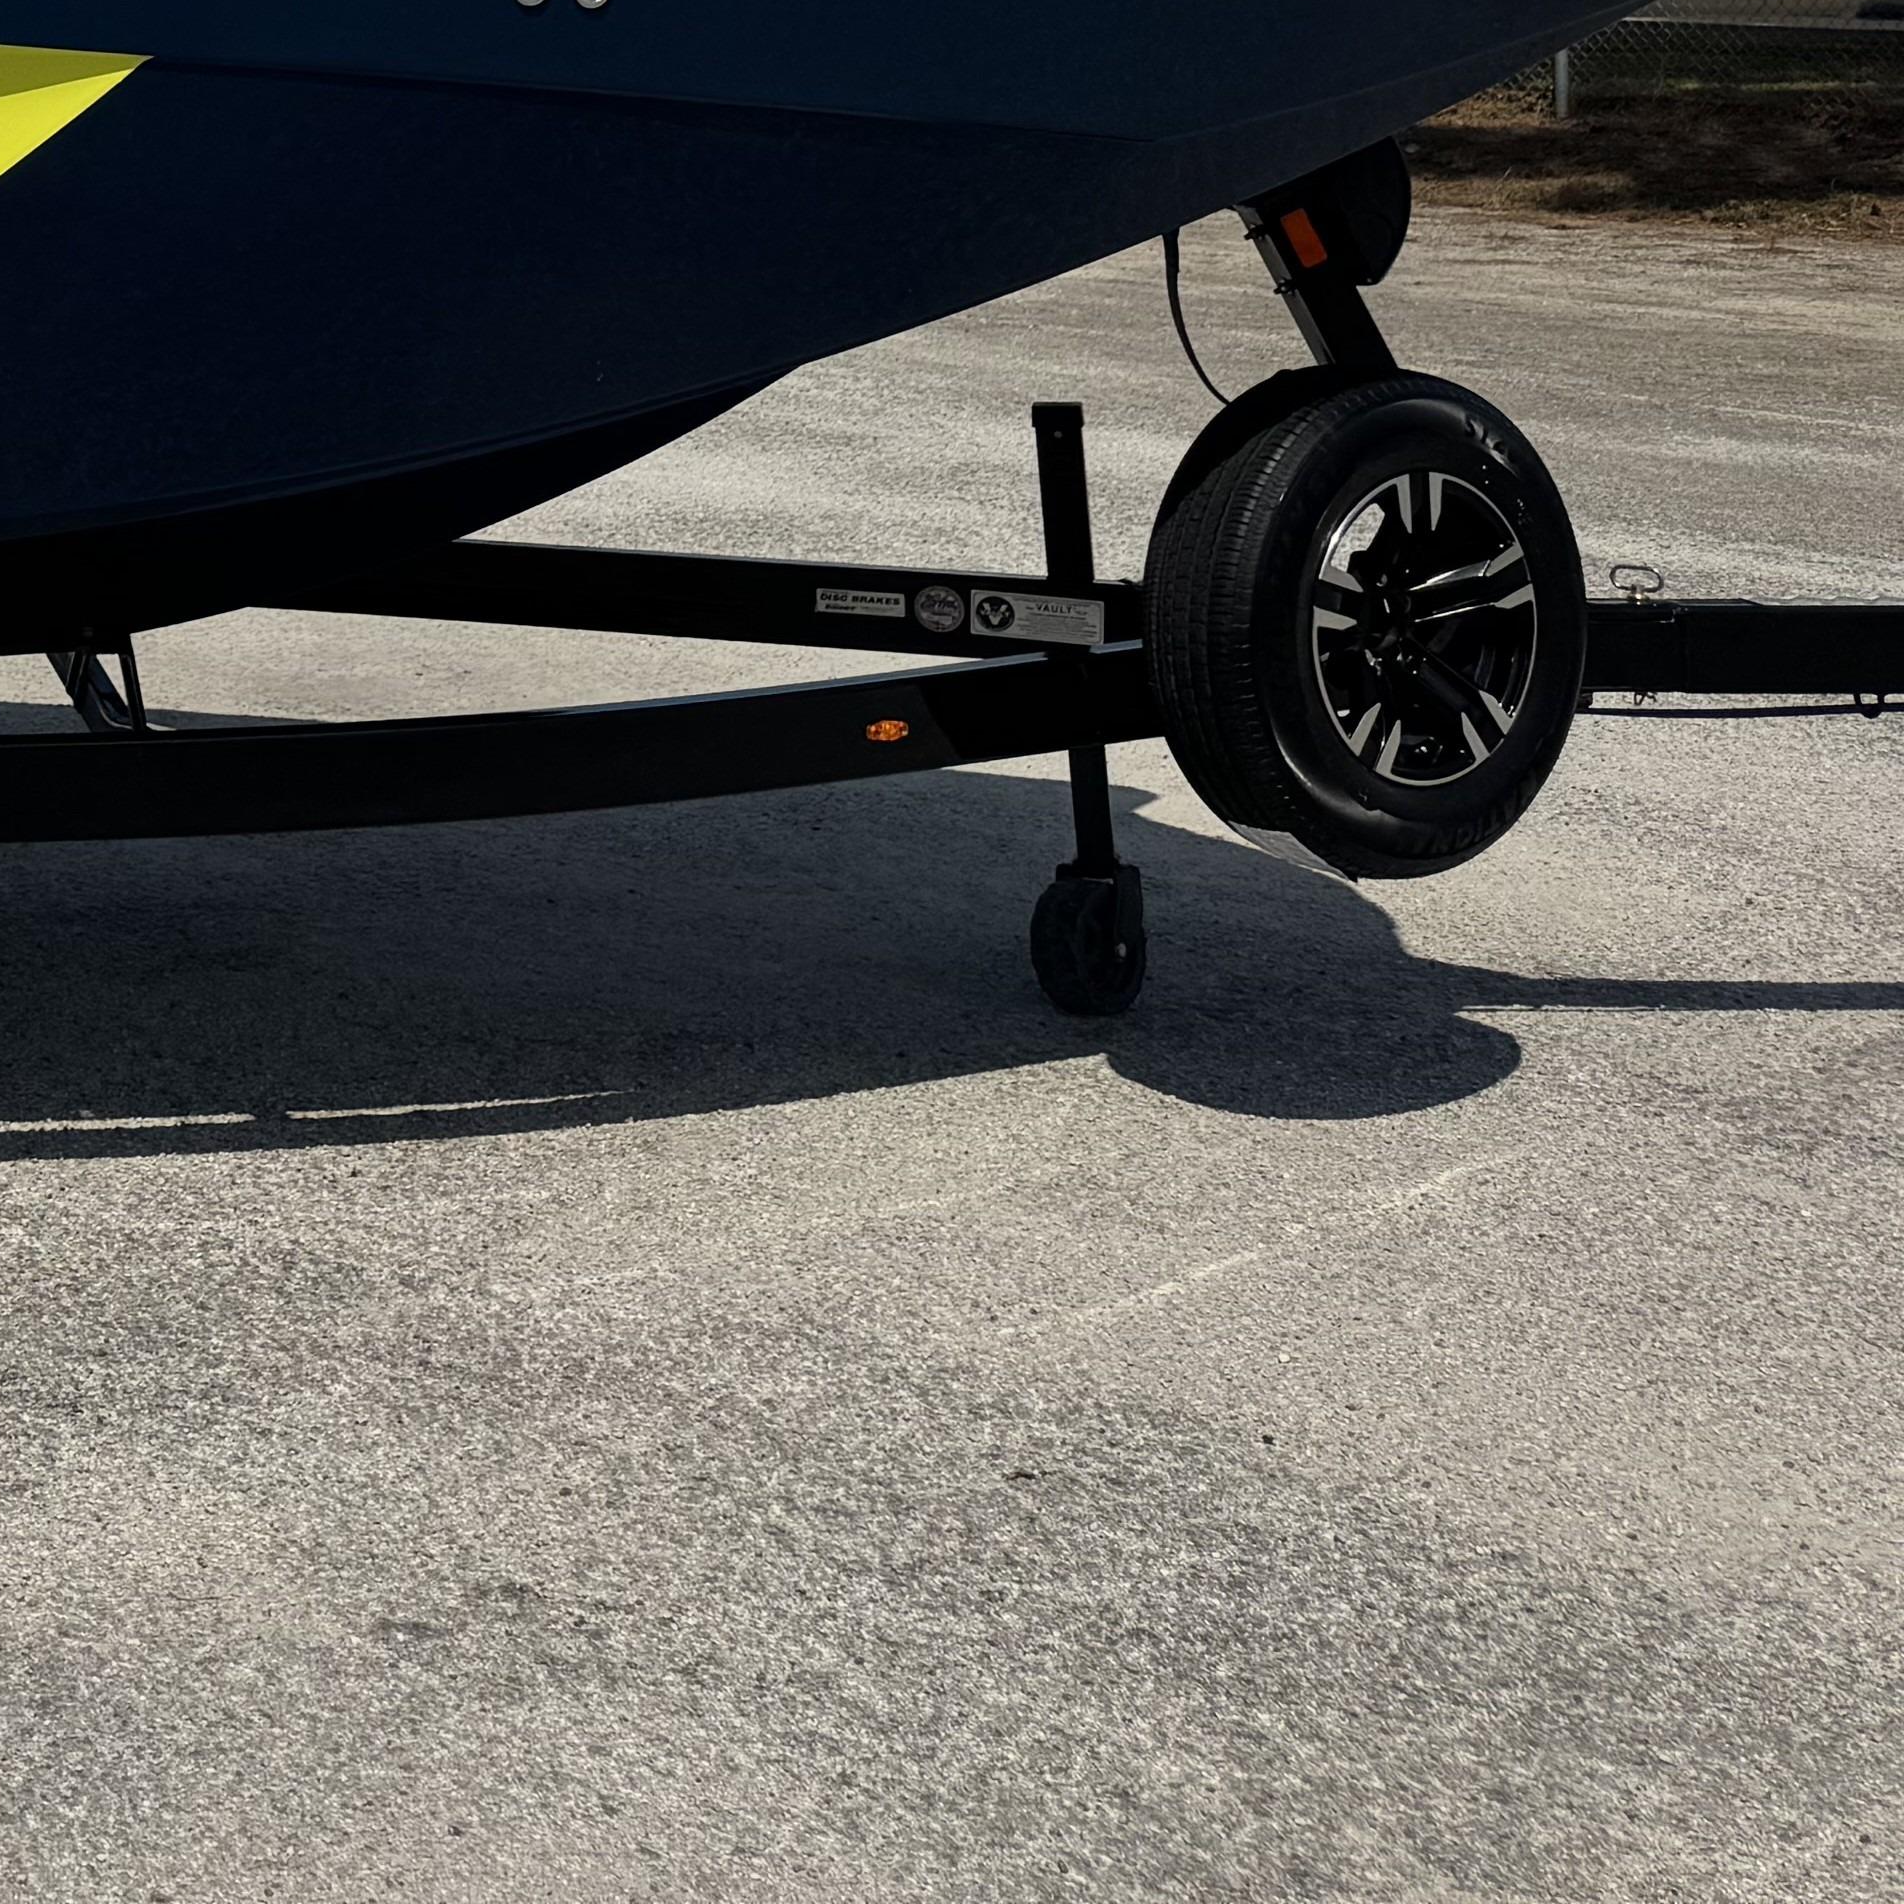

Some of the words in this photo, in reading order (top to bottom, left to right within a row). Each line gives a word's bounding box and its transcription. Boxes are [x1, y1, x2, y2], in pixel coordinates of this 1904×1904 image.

[820, 592, 848, 602] DISC
[851, 595, 900, 605] BRAKES
[1035, 602, 1073, 614] VAULT
